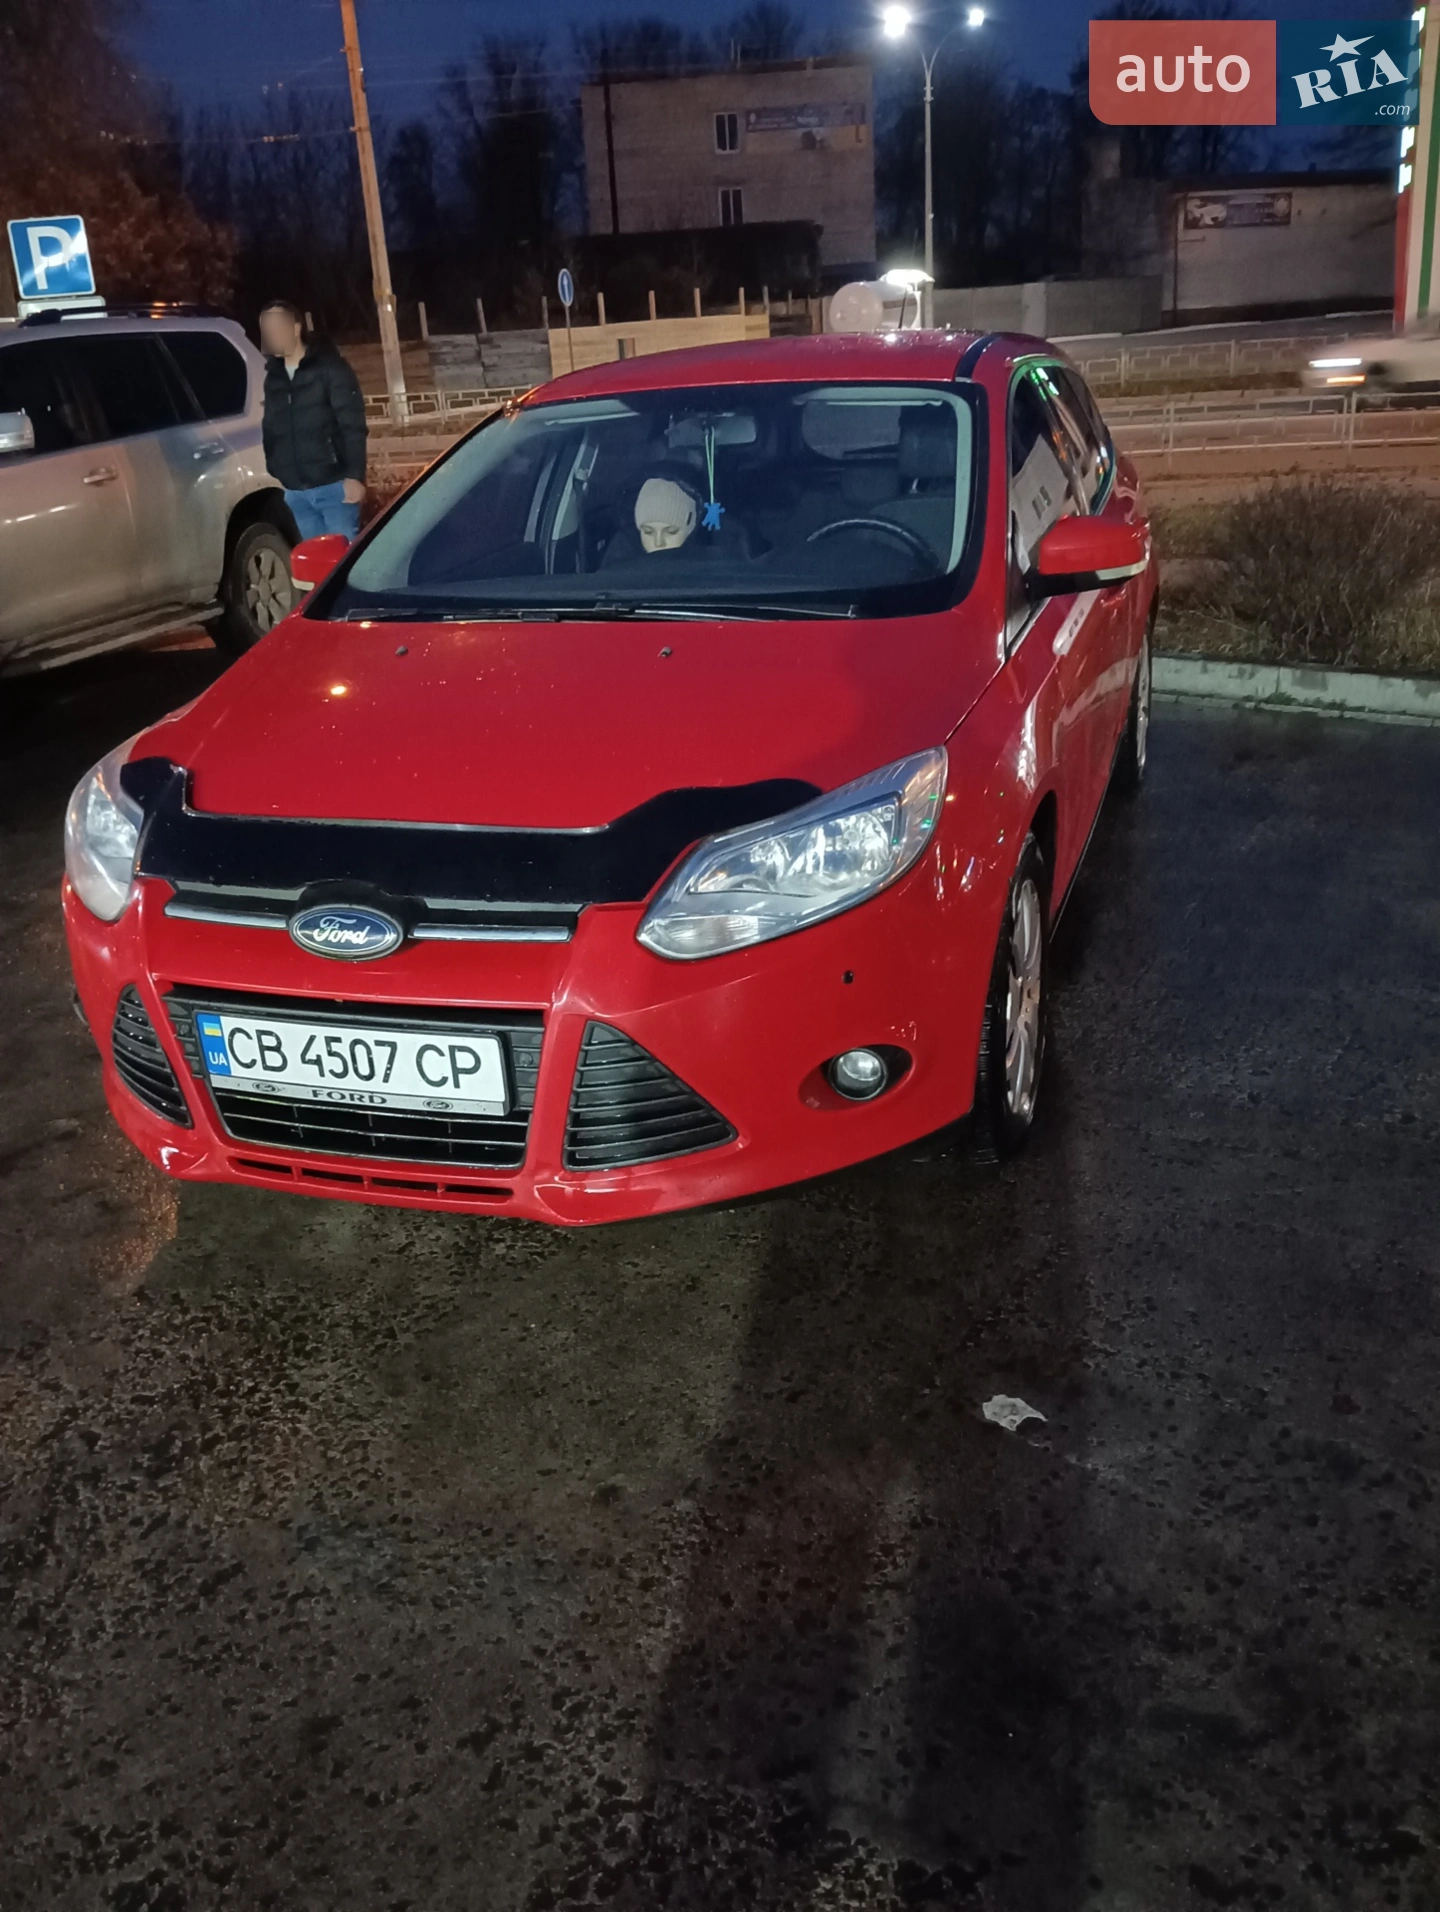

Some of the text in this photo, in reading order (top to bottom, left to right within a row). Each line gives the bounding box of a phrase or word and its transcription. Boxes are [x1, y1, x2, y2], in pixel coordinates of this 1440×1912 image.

[26, 225, 73, 290] P
[312, 915, 371, 945] Ford
[208, 1051, 229, 1067] UA
[227, 1026, 482, 1089] CB 4507 CP
[311, 1089, 388, 1105] FORD
